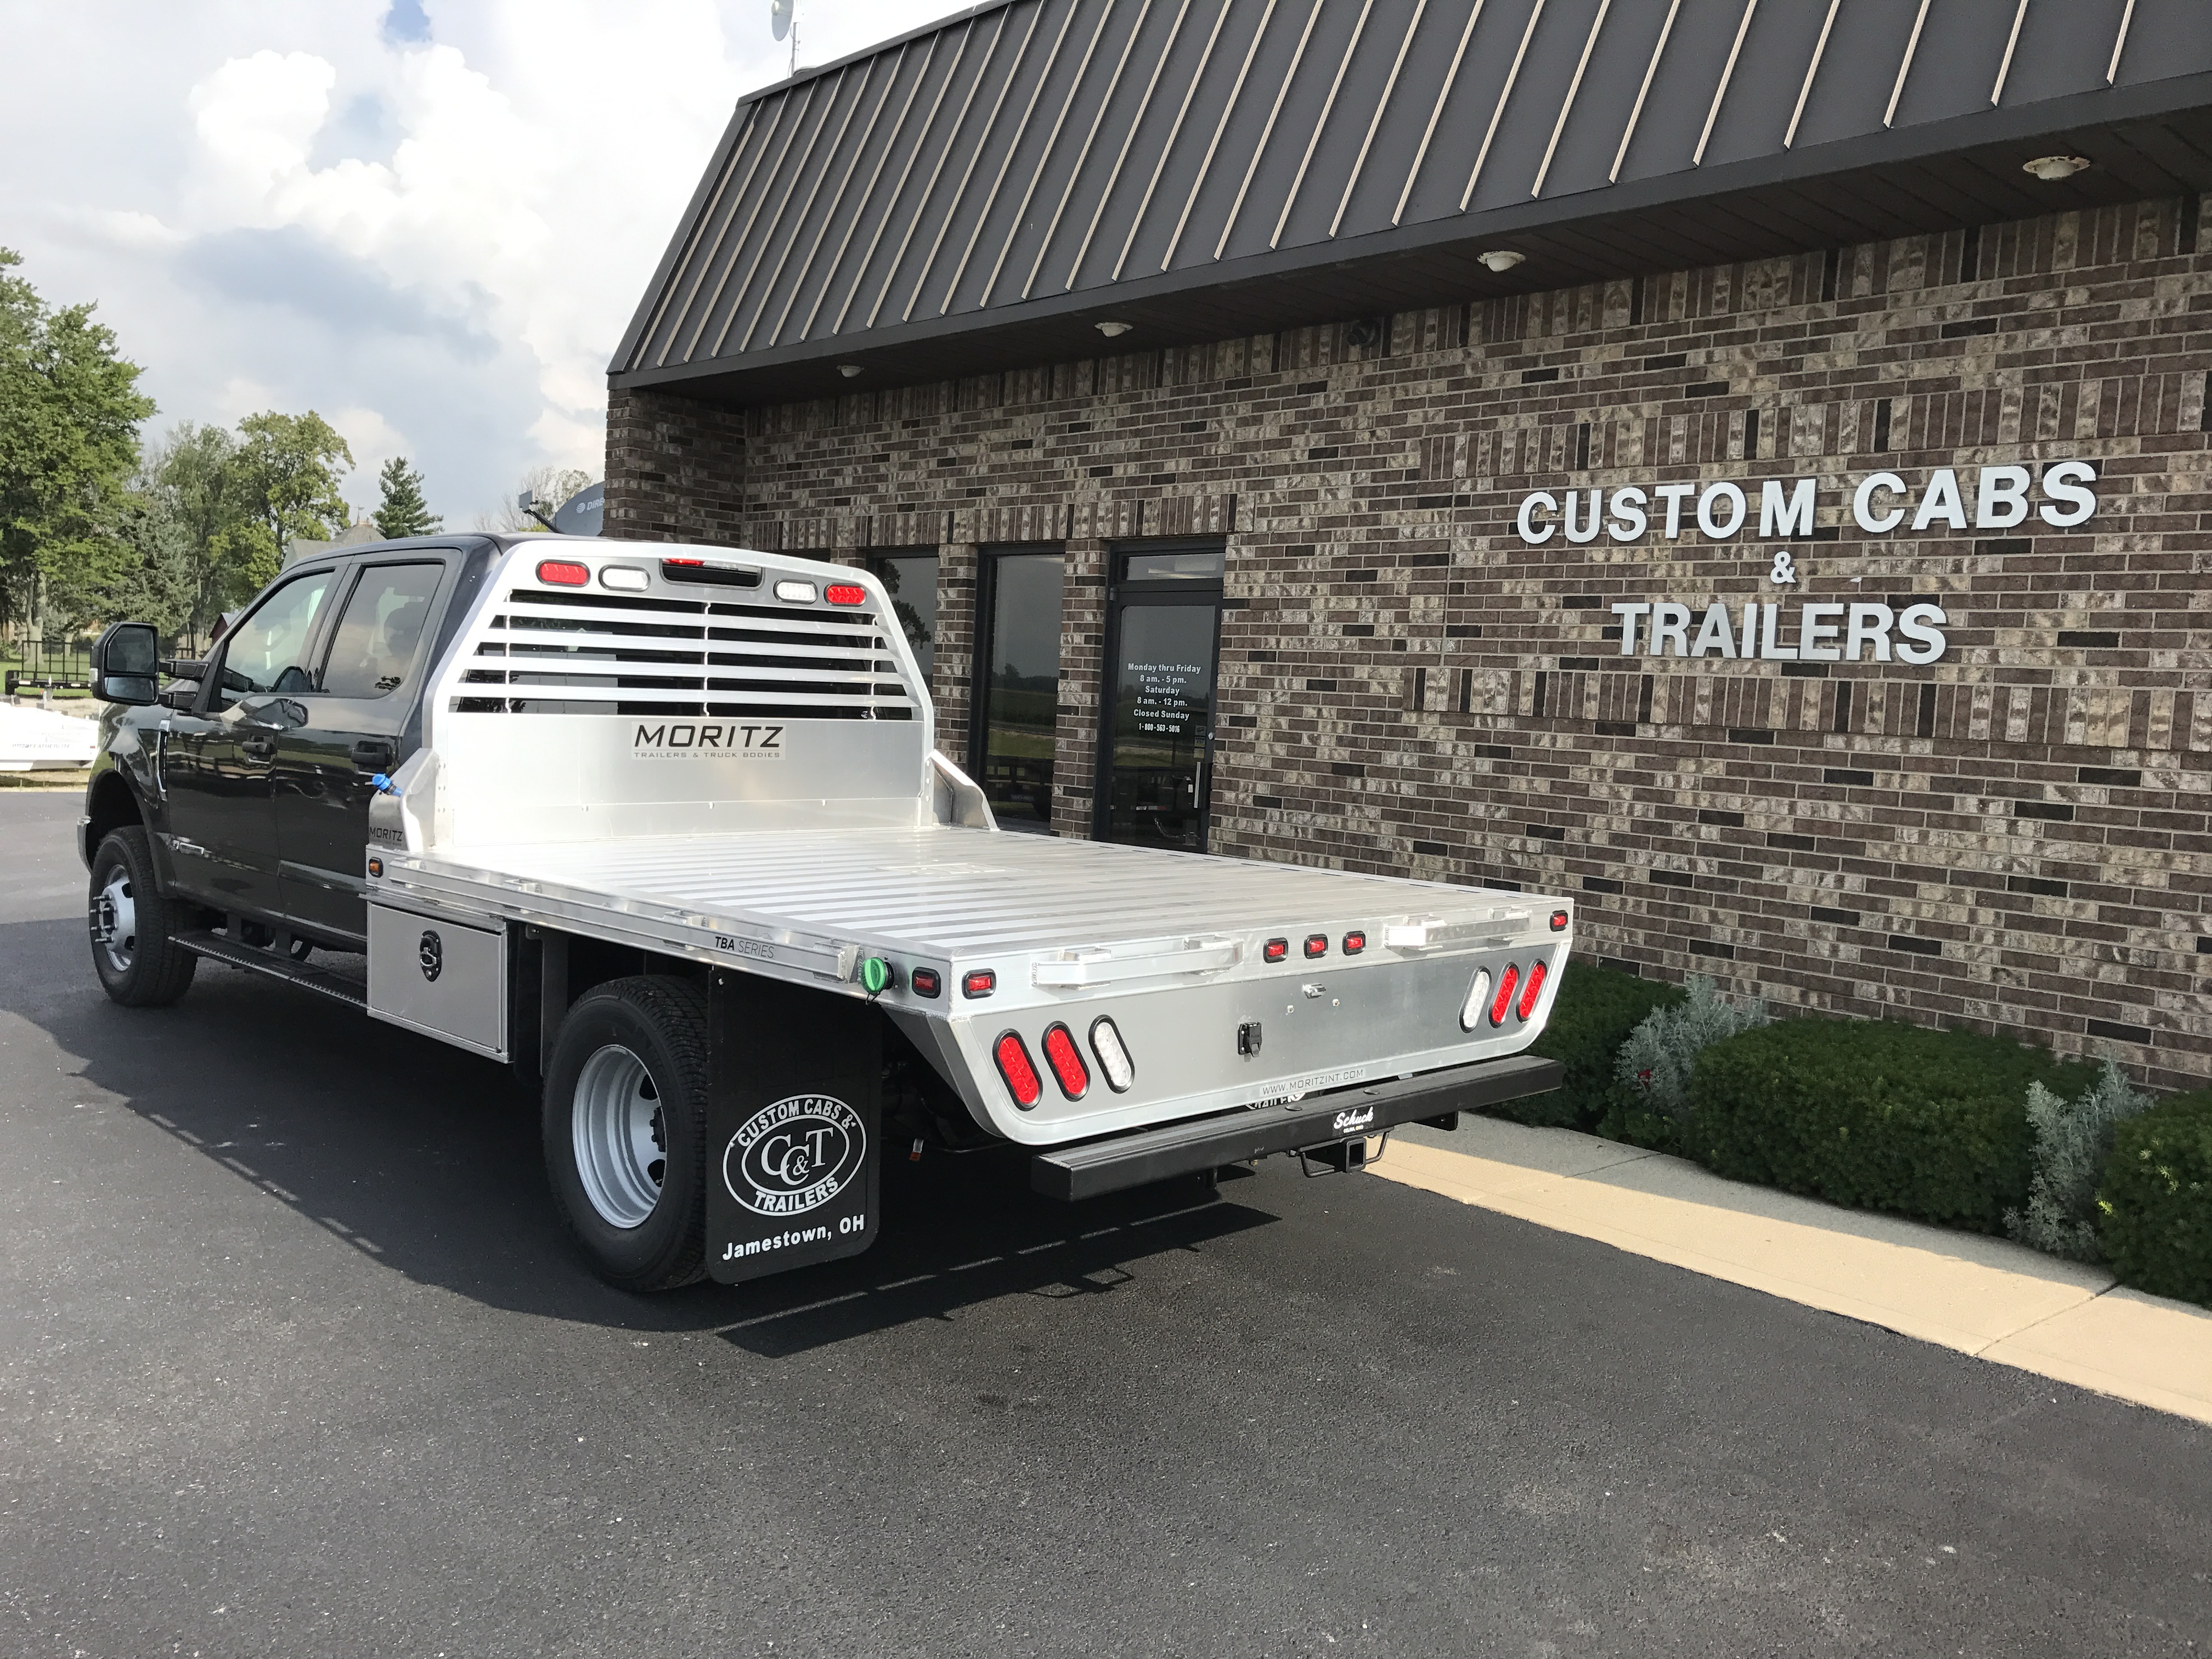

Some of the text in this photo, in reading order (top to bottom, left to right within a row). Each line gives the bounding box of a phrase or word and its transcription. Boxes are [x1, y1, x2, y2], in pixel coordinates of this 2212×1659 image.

[587, 497, 605, 510] DIRE
[1516, 461, 2097, 544] CUSTOM CABS
[1770, 551, 1796, 584] &
[1611, 602, 1948, 665] TRAILERS
[1128, 663, 1156, 673] Monday
[1176, 664, 1201, 674] Friday
[1145, 686, 1180, 696] Saturday
[1133, 709, 1189, 721] Closed Sunday
[634, 725, 783, 748] MORITZ
[370, 827, 403, 842] MORITZ
[715, 936, 775, 958] TBA SERIES
[1262, 1069, 1363, 1095] WWW.MORITZINT.COM
[738, 1098, 854, 1147] CUSTOM CABS &
[1334, 1106, 1374, 1130] Schuck
[754, 1177, 839, 1212] TRAILERS
[722, 1214, 864, 1261] Jamestown, OH
